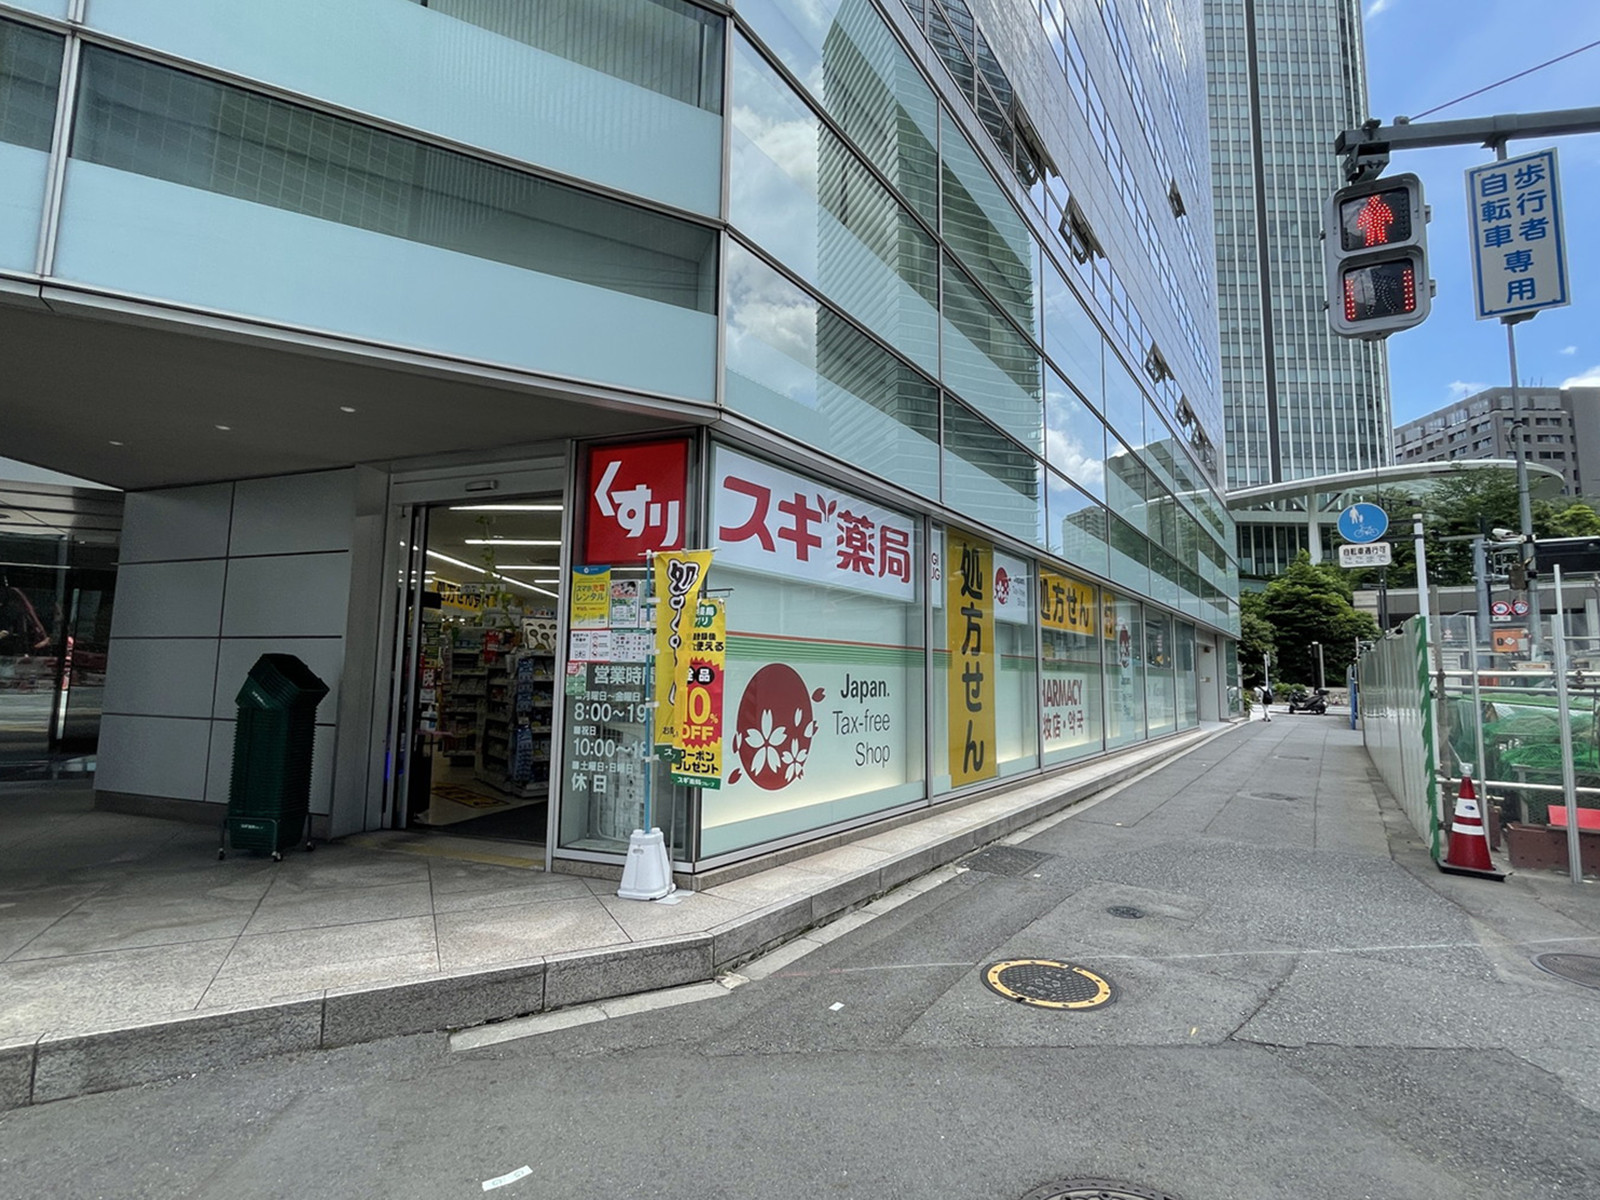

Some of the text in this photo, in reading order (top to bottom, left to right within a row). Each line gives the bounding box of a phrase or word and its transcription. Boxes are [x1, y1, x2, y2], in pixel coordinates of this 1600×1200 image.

[1480, 172, 1515, 248] 自転車
[1514, 163, 1549, 242] 歩行者
[1503, 249, 1536, 304] 専用
[594, 461, 680, 547] くすり
[719, 475, 910, 584] スギ薬局
[840, 673, 890, 703] Japan.
[960, 542, 984, 774] 処方せん
[832, 709, 891, 735] Tax-free
[855, 742, 891, 768] Shop
